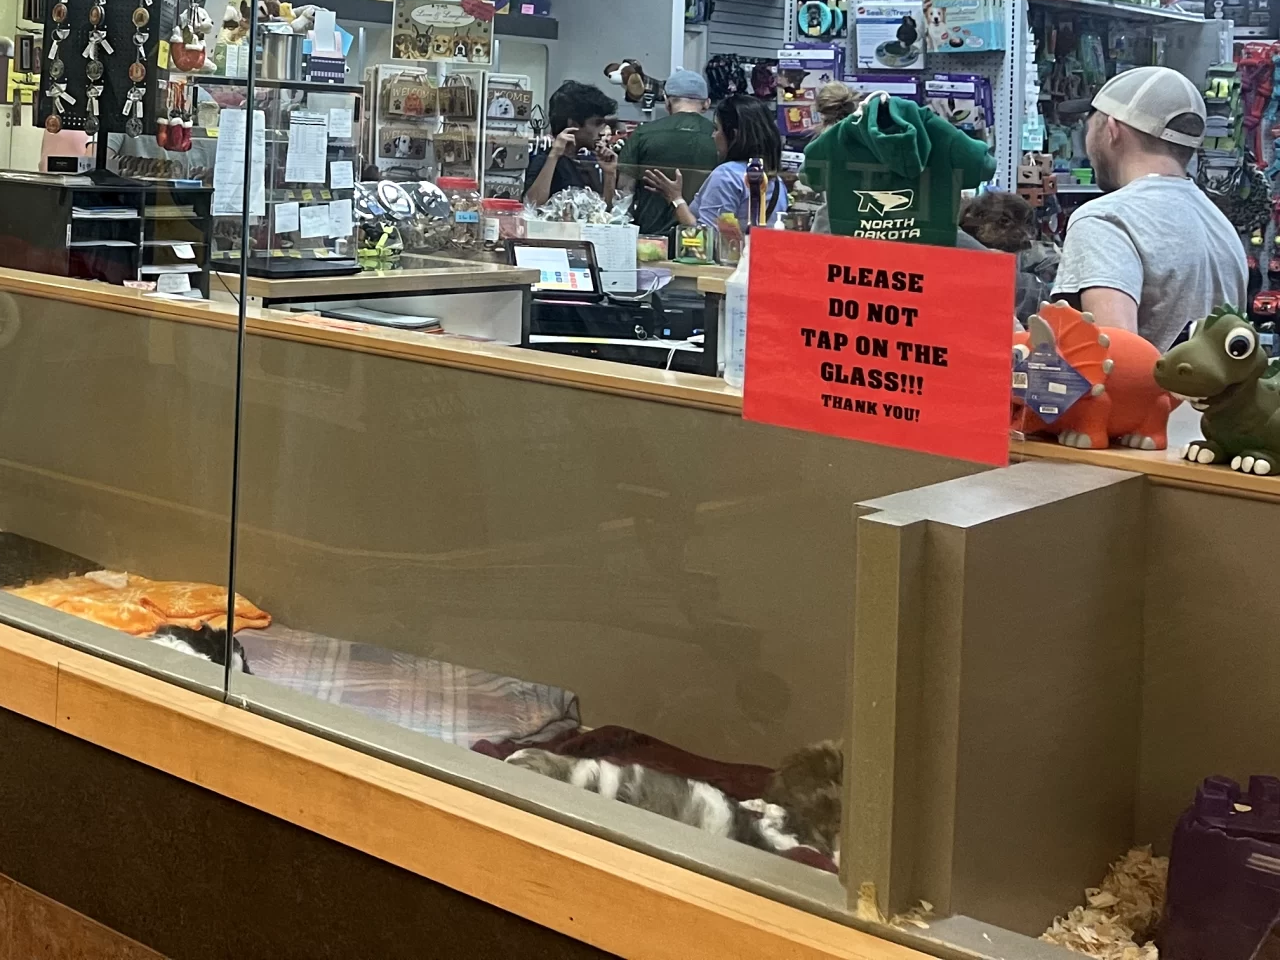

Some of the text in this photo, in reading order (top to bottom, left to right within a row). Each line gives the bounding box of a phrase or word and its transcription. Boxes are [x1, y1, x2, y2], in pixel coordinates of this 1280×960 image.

[853, 228, 921, 240] DAKOTA
[860, 217, 915, 230] NORTH
[827, 263, 925, 294] PLEASE
[828, 297, 919, 328] DO NOT
[800, 327, 948, 368] TAP ON THE
[820, 361, 924, 396] GLASS!!!
[821, 393, 921, 423] THANK YOU!
